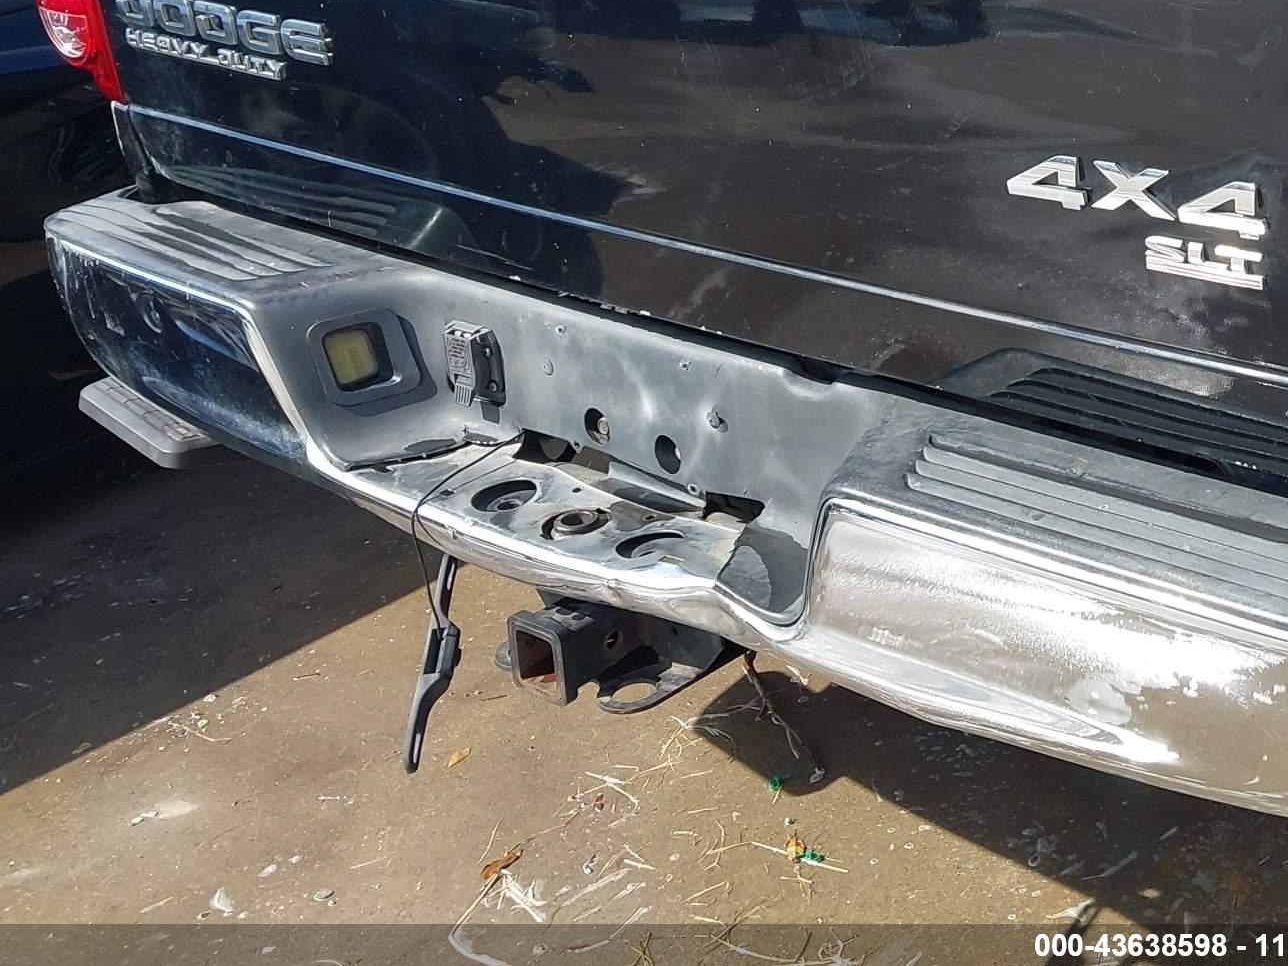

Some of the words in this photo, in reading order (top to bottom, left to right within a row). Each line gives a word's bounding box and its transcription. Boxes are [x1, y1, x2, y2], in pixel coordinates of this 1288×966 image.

[125, 27, 210, 61] HEAVY
[217, 47, 287, 81] DUTY
[1145, 235, 1264, 284] SLT
